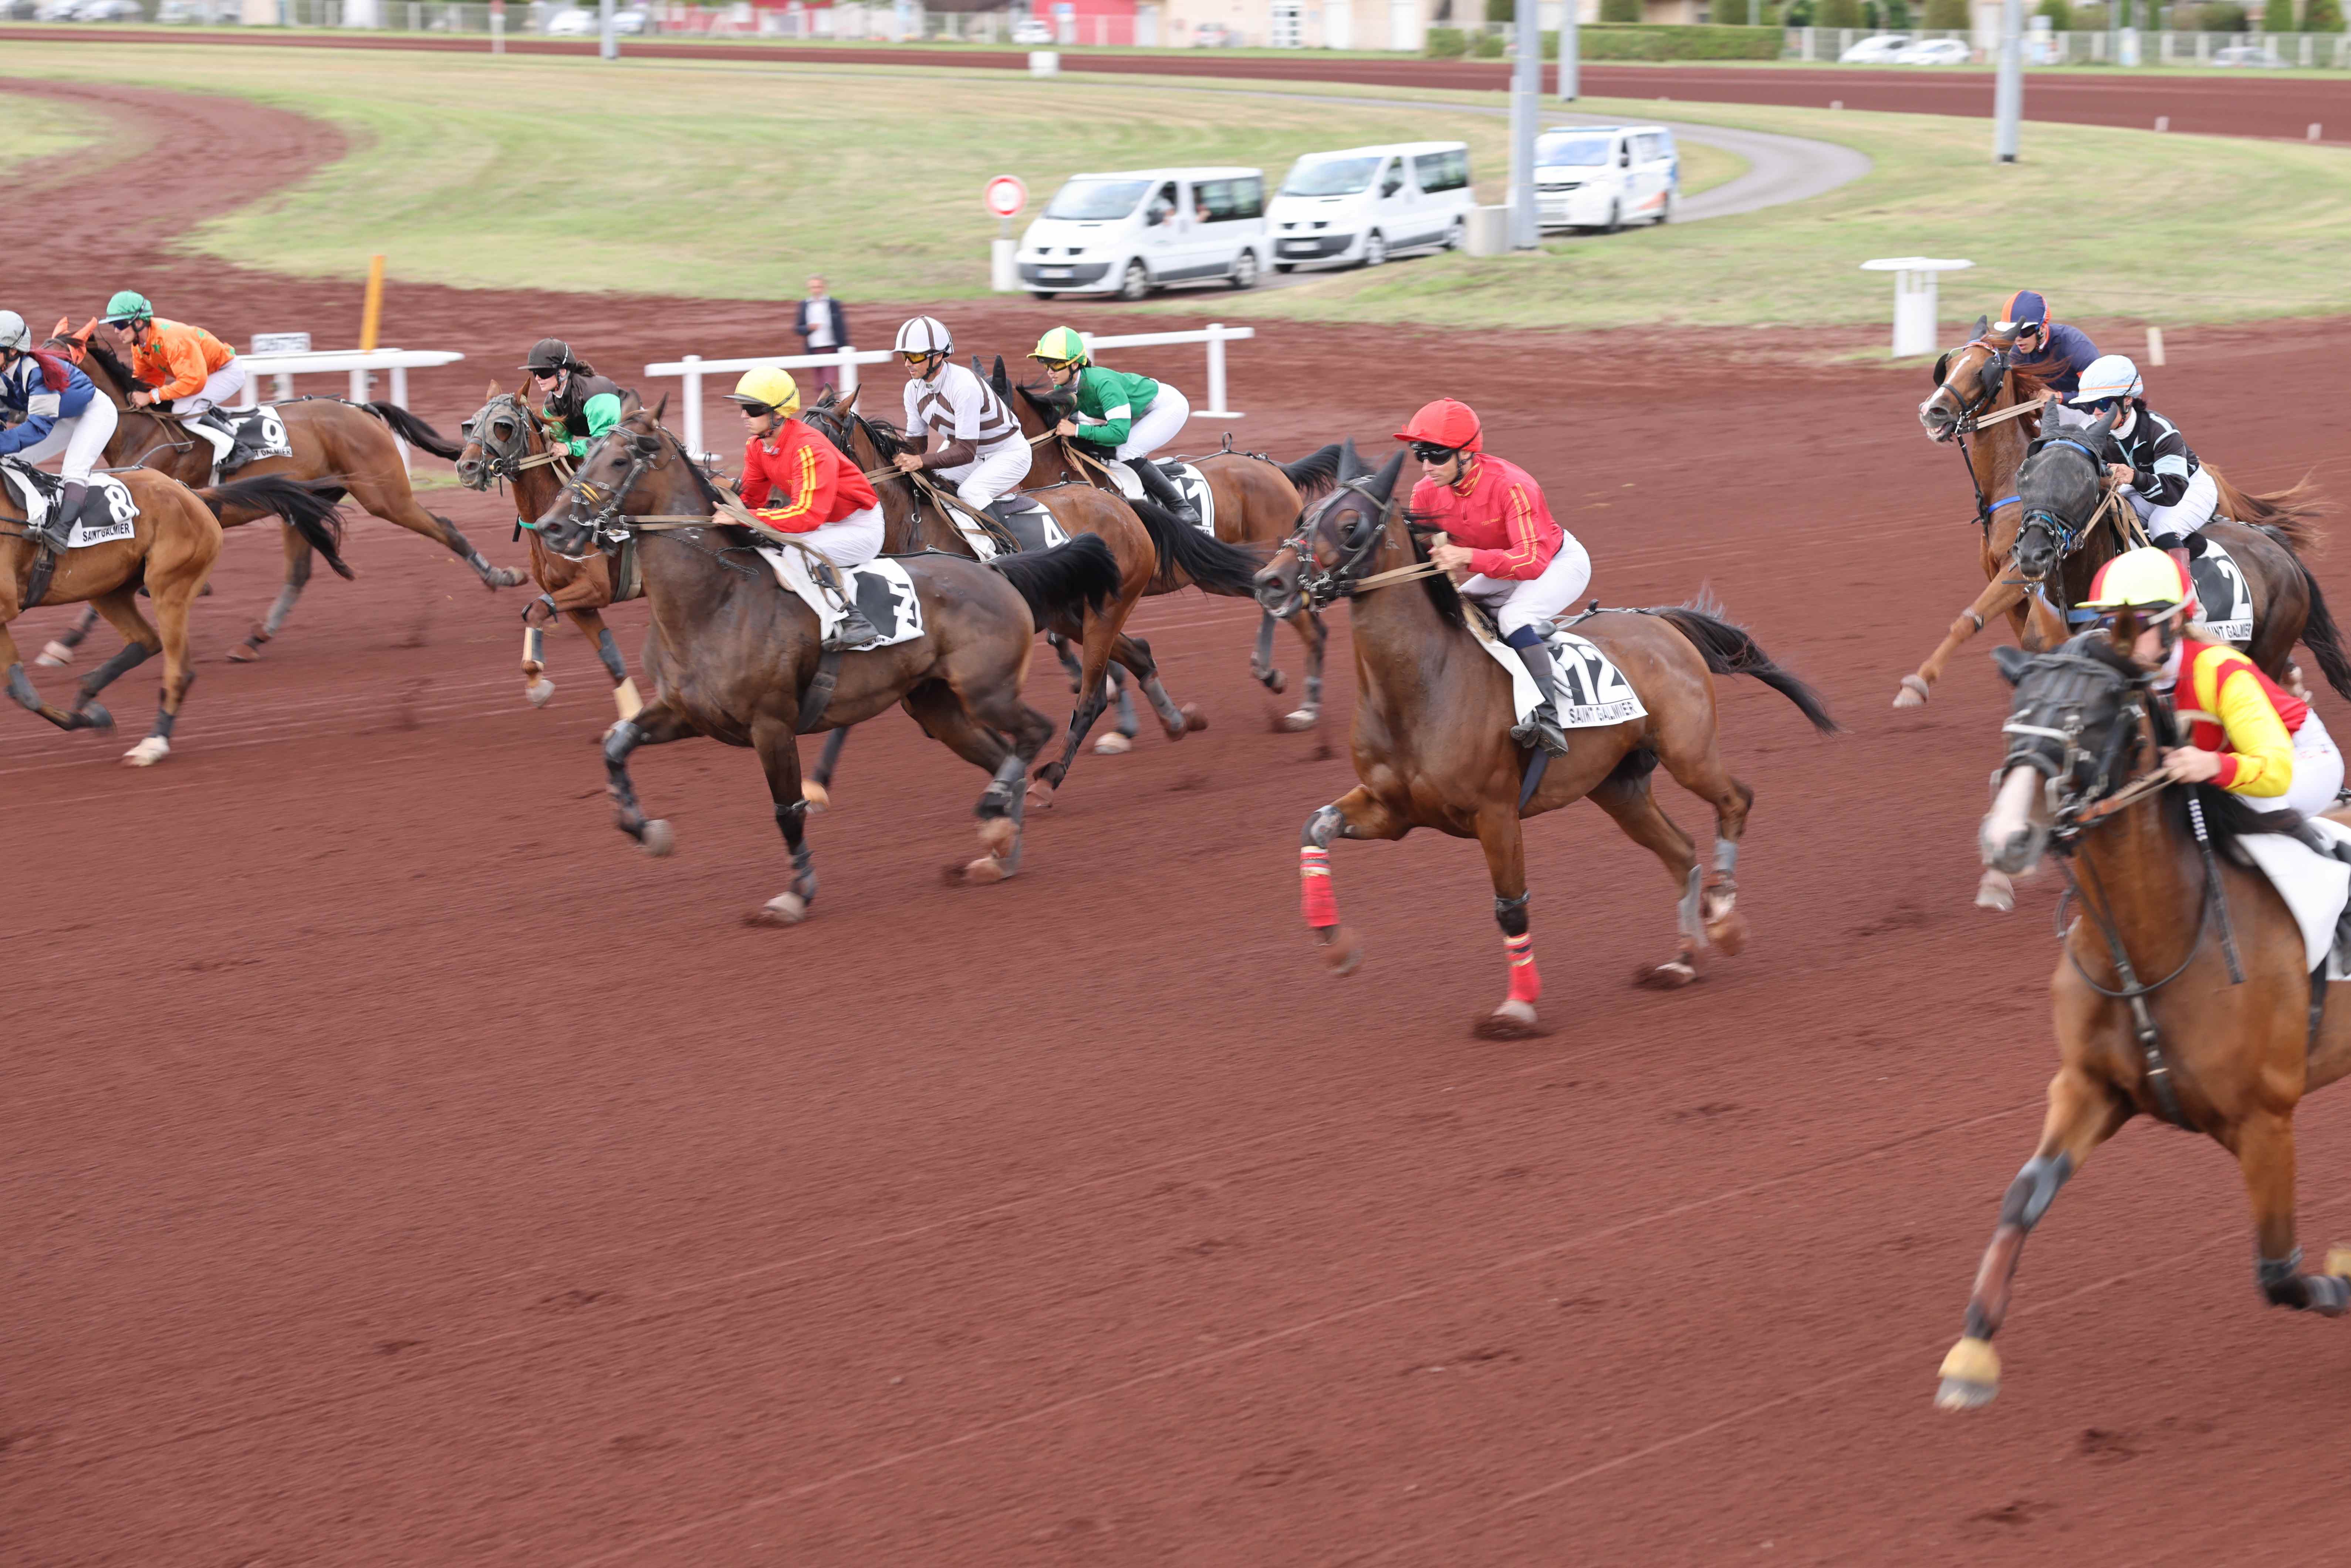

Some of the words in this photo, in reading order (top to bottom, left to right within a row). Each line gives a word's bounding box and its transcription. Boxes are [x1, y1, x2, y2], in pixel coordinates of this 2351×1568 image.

[262, 418, 286, 448] 9
[104, 485, 136, 524] 8
[83, 529, 101, 542] SAINT
[101, 523, 130, 538] GALMIER
[1042, 515, 1070, 549] 4
[2216, 559, 2252, 620] 2
[887, 581, 915, 639] 7
[2226, 623, 2251, 638] GALMIER
[1556, 644, 1634, 704] 12
[1568, 707, 1595, 724] SAINT
[1596, 702, 1638, 721] GALMIER
